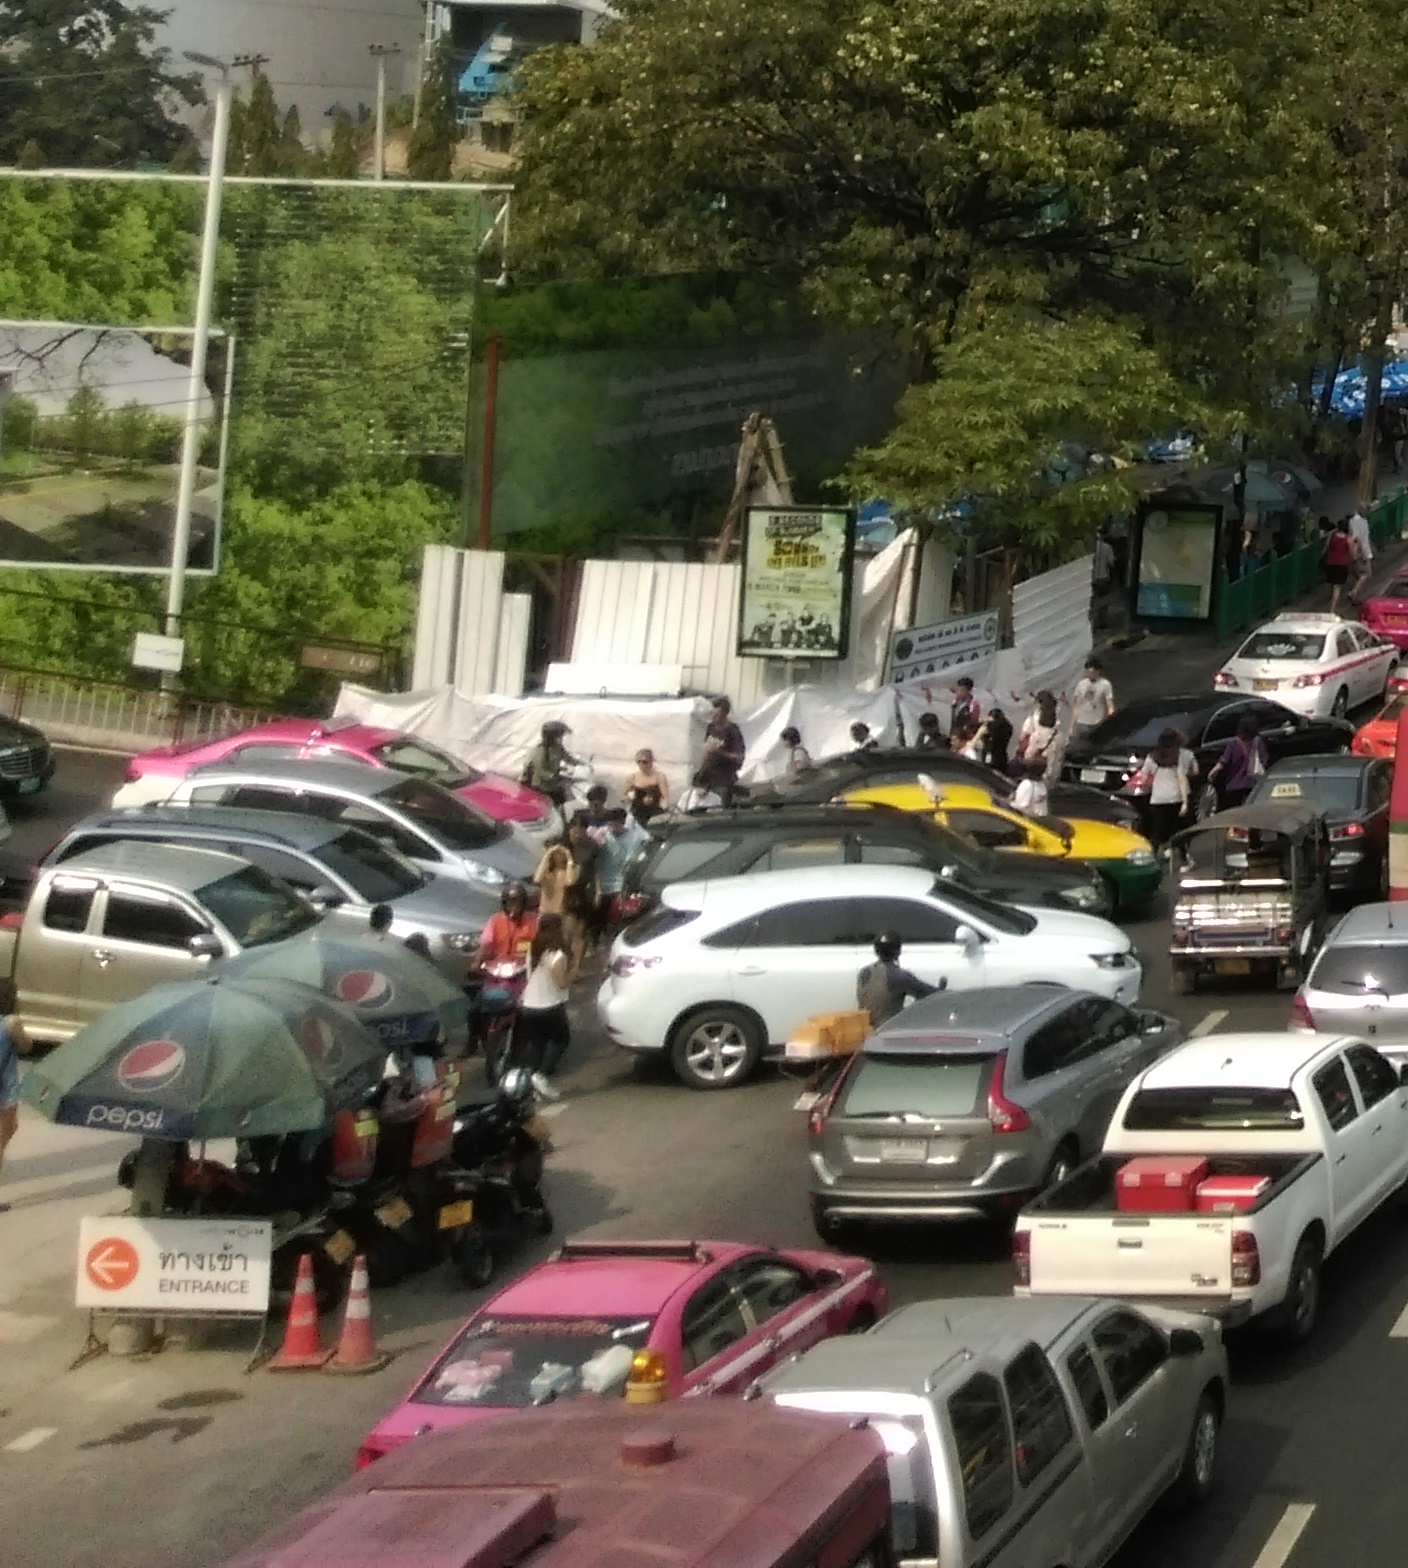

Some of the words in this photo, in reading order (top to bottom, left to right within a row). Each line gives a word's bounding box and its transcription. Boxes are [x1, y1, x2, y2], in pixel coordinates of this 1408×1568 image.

[86, 1104, 163, 1131] pepsi
[158, 1244, 249, 1276] ทางเข้า
[158, 1279, 250, 1295] ENTRANCE
